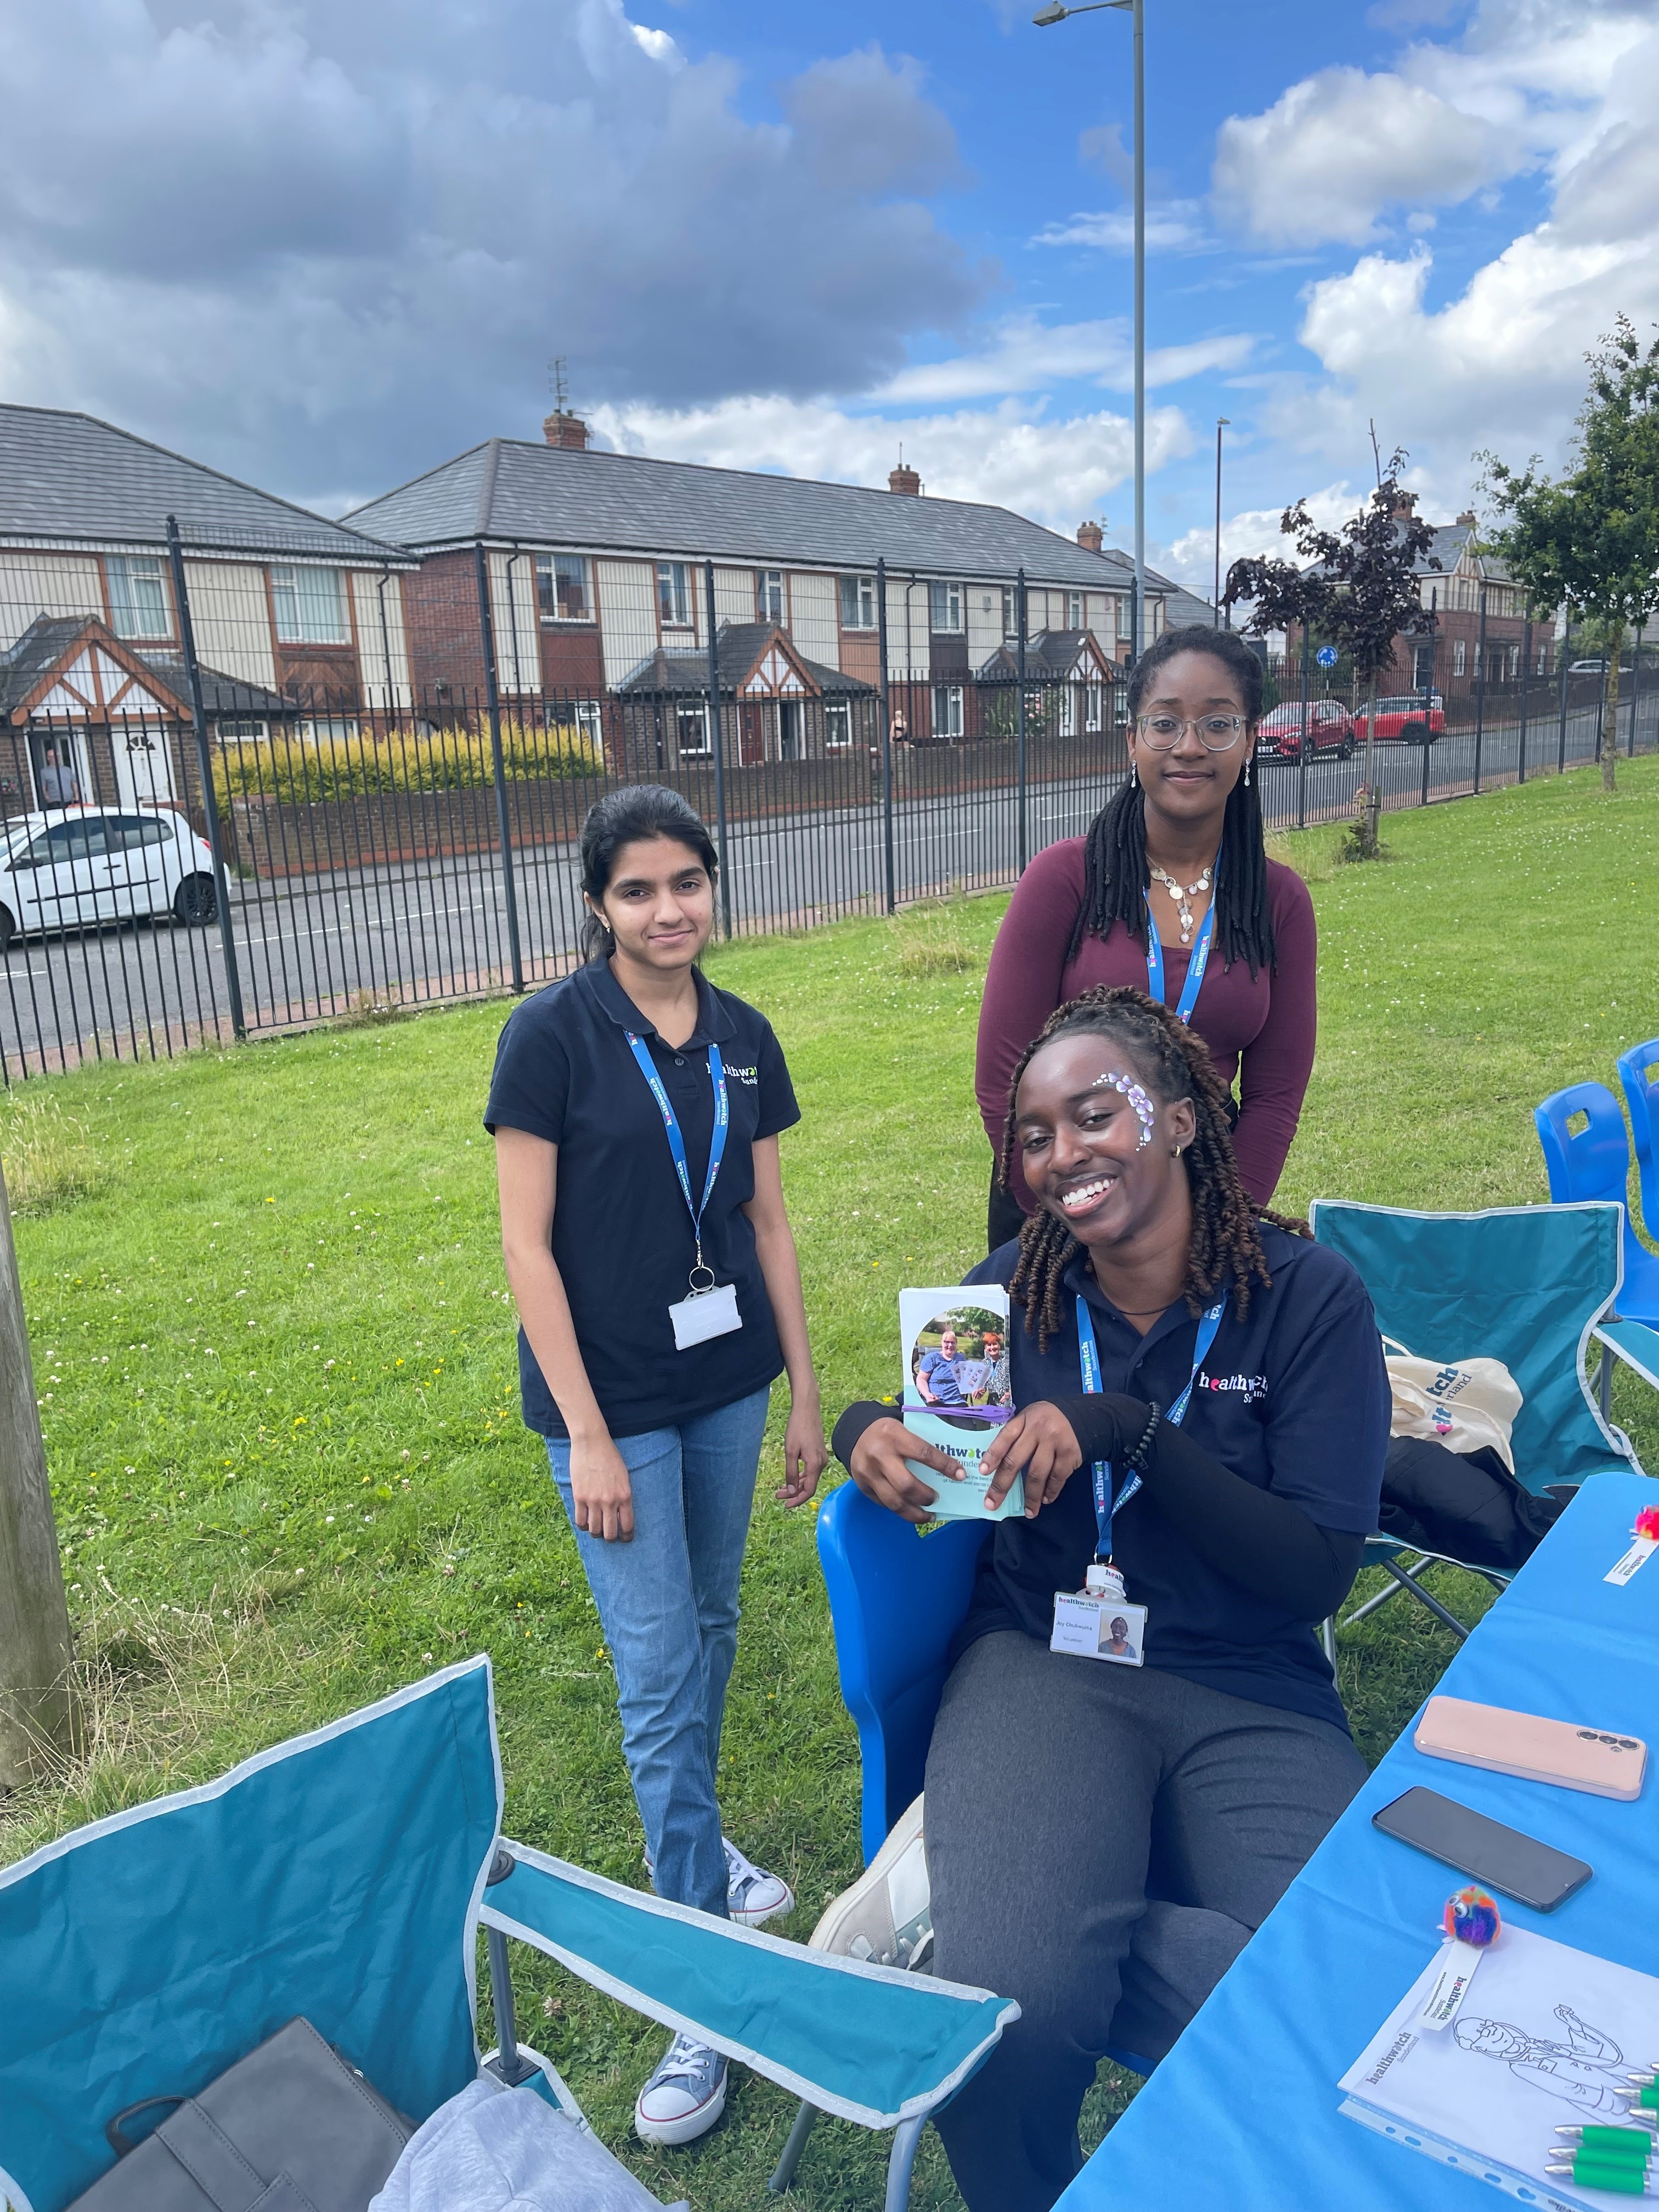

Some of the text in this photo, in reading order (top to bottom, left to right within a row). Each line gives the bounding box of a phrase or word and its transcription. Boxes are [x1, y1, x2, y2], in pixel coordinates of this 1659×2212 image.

[1194, 935, 1209, 977] healthwatch
[718, 1079, 728, 1126] healthwatch
[1059, 1596, 1099, 1607] healthwatch
[1437, 1976, 1467, 2021] healthwatch
[1365, 2032, 1412, 2085] healthwatch
[1397, 2036, 1420, 2063] Sunderland
